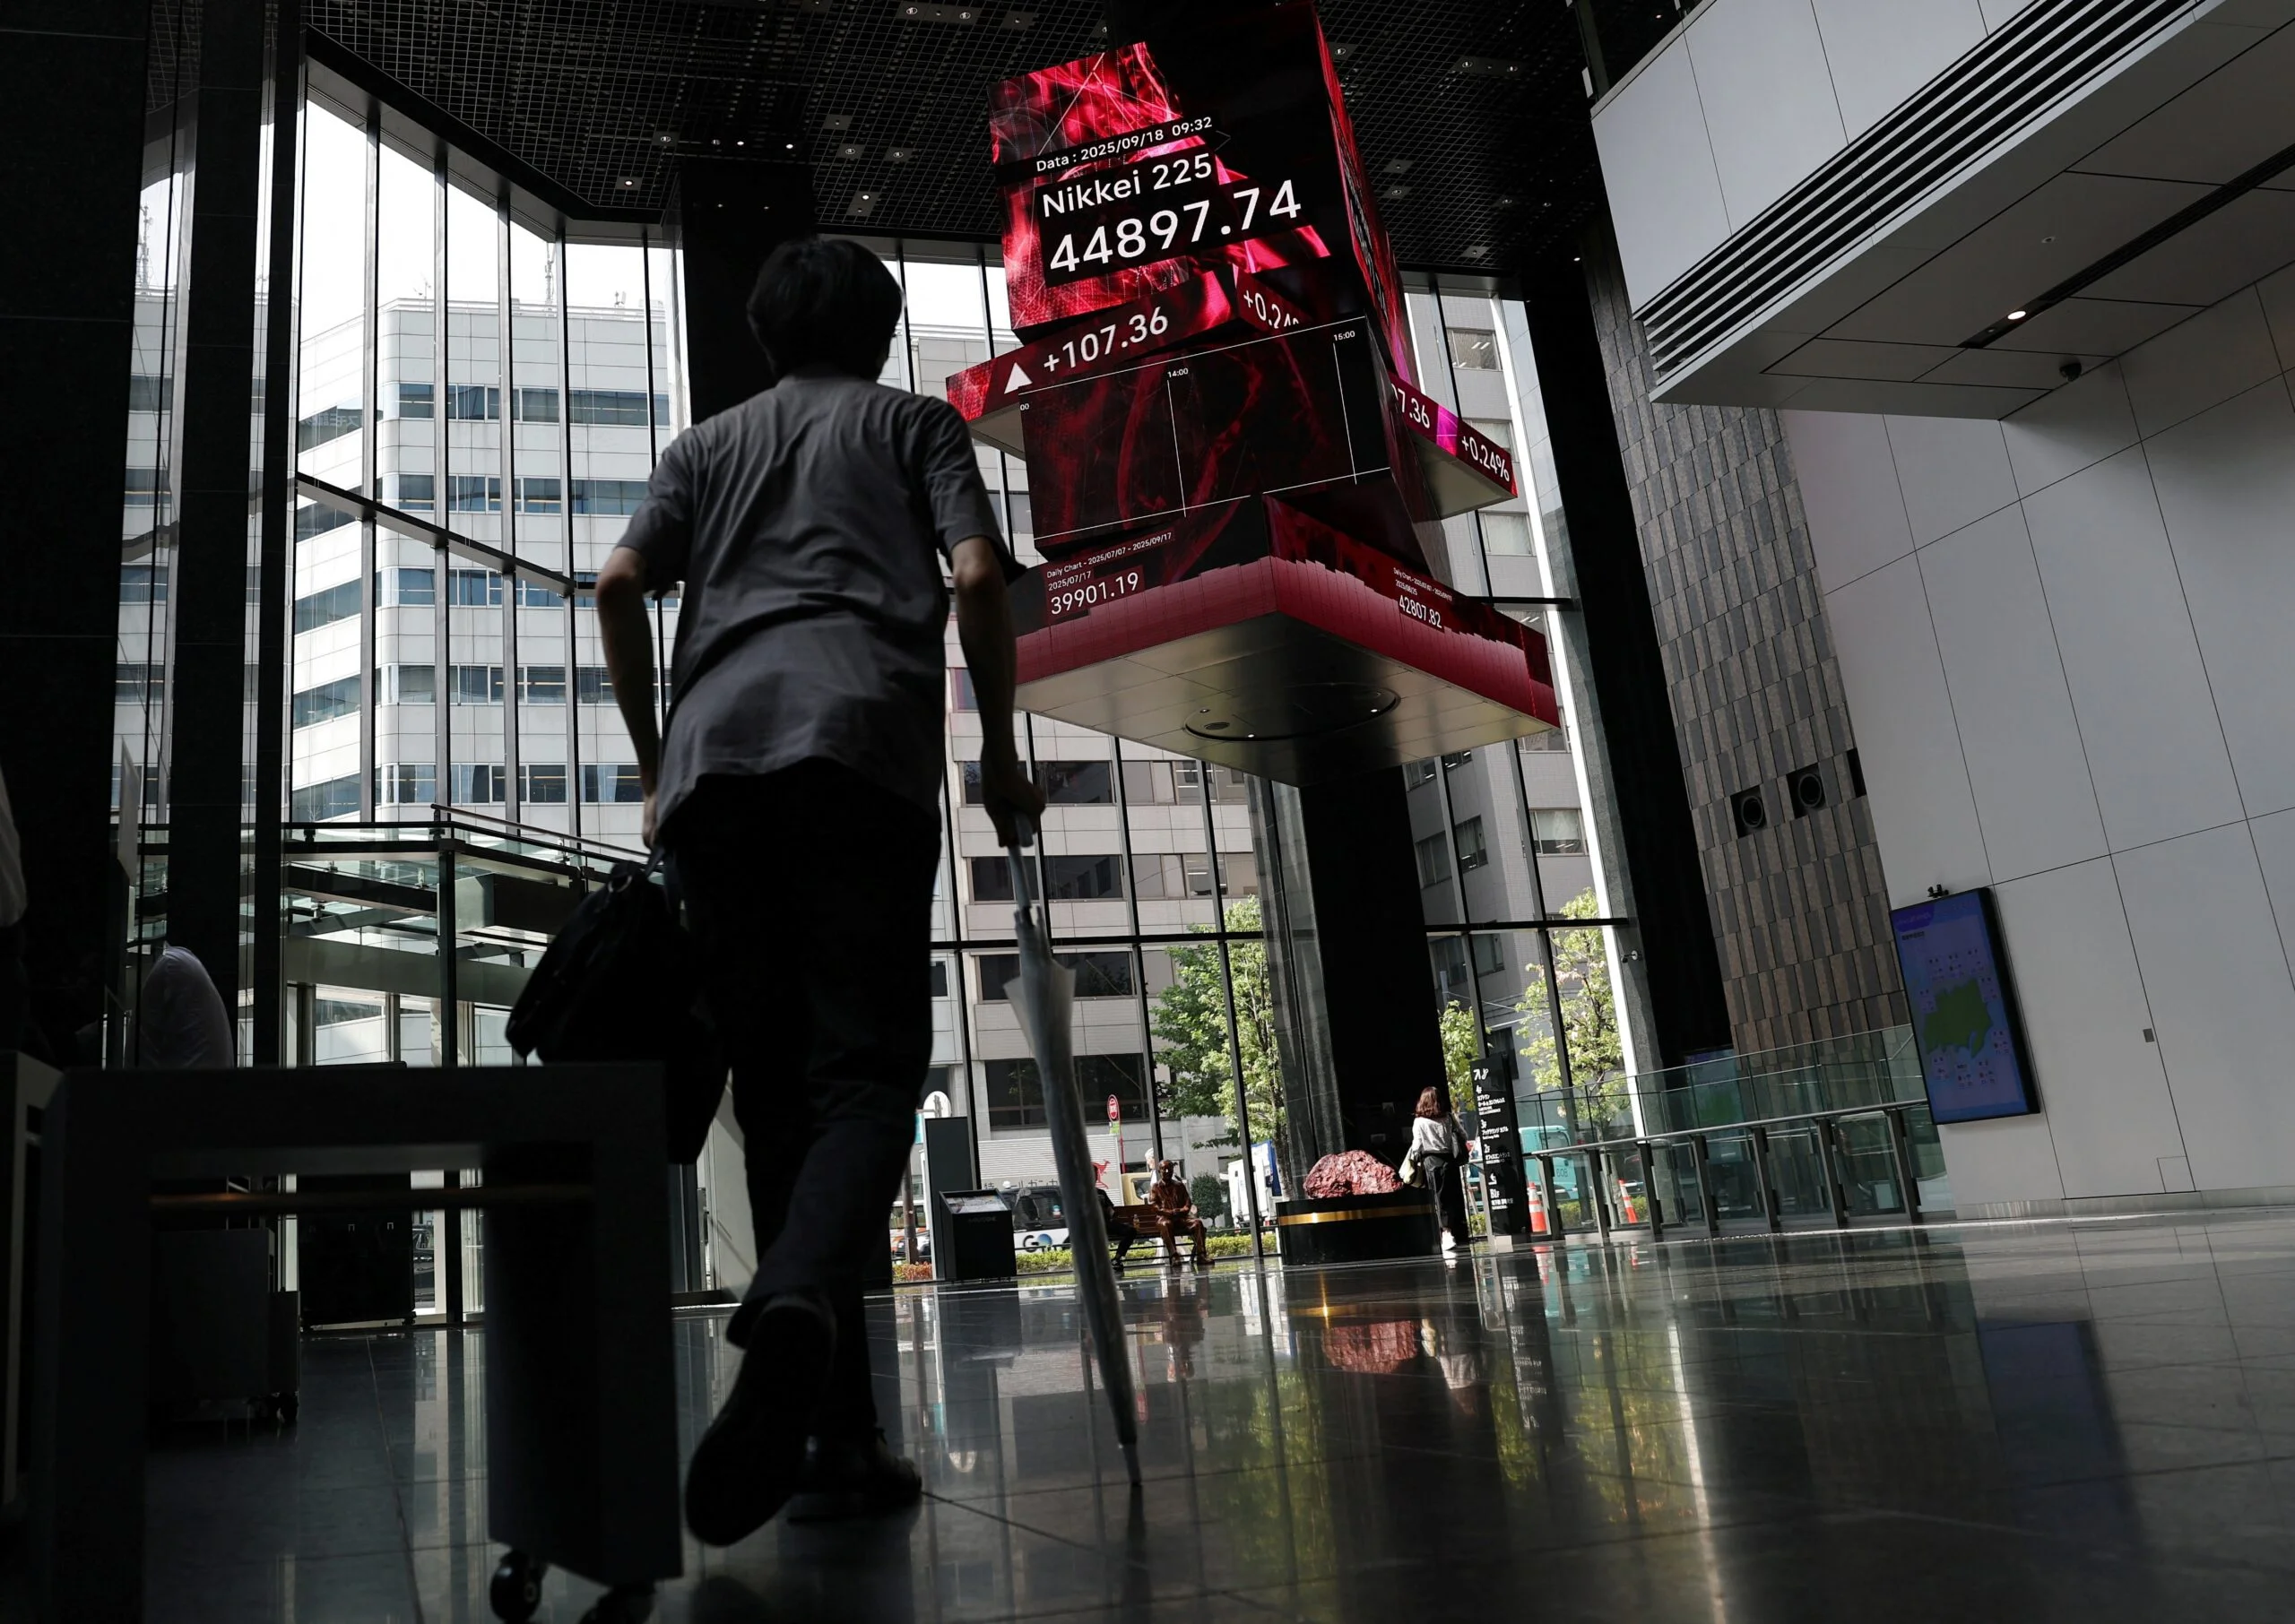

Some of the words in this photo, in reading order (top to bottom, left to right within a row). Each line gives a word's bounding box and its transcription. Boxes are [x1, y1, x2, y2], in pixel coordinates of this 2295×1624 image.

[1036, 156, 1070, 172] Data
[1080, 129, 1165, 160] 2025/09/18
[1172, 117, 1212, 136] 09:32
[1043, 168, 1141, 218] Nikkei
[1152, 152, 1212, 190] 225
[1050, 179, 1302, 272] 44897.74
[1044, 306, 1168, 372] +107.36
[1333, 330, 1355, 341] 15:00
[1167, 367, 1189, 378] 14:00
[1461, 436, 1510, 482] +0.24%
[1046, 568, 1063, 578] Daily
[1064, 561, 1082, 572] Chart
[1087, 547, 1126, 565] 2025/07/07
[1132, 531, 1172, 551] 2025/09/17
[1048, 570, 1091, 592] 2025/07/17
[1051, 572, 1139, 615] 39901.19
[1399, 594, 1442, 629] 42807.82
